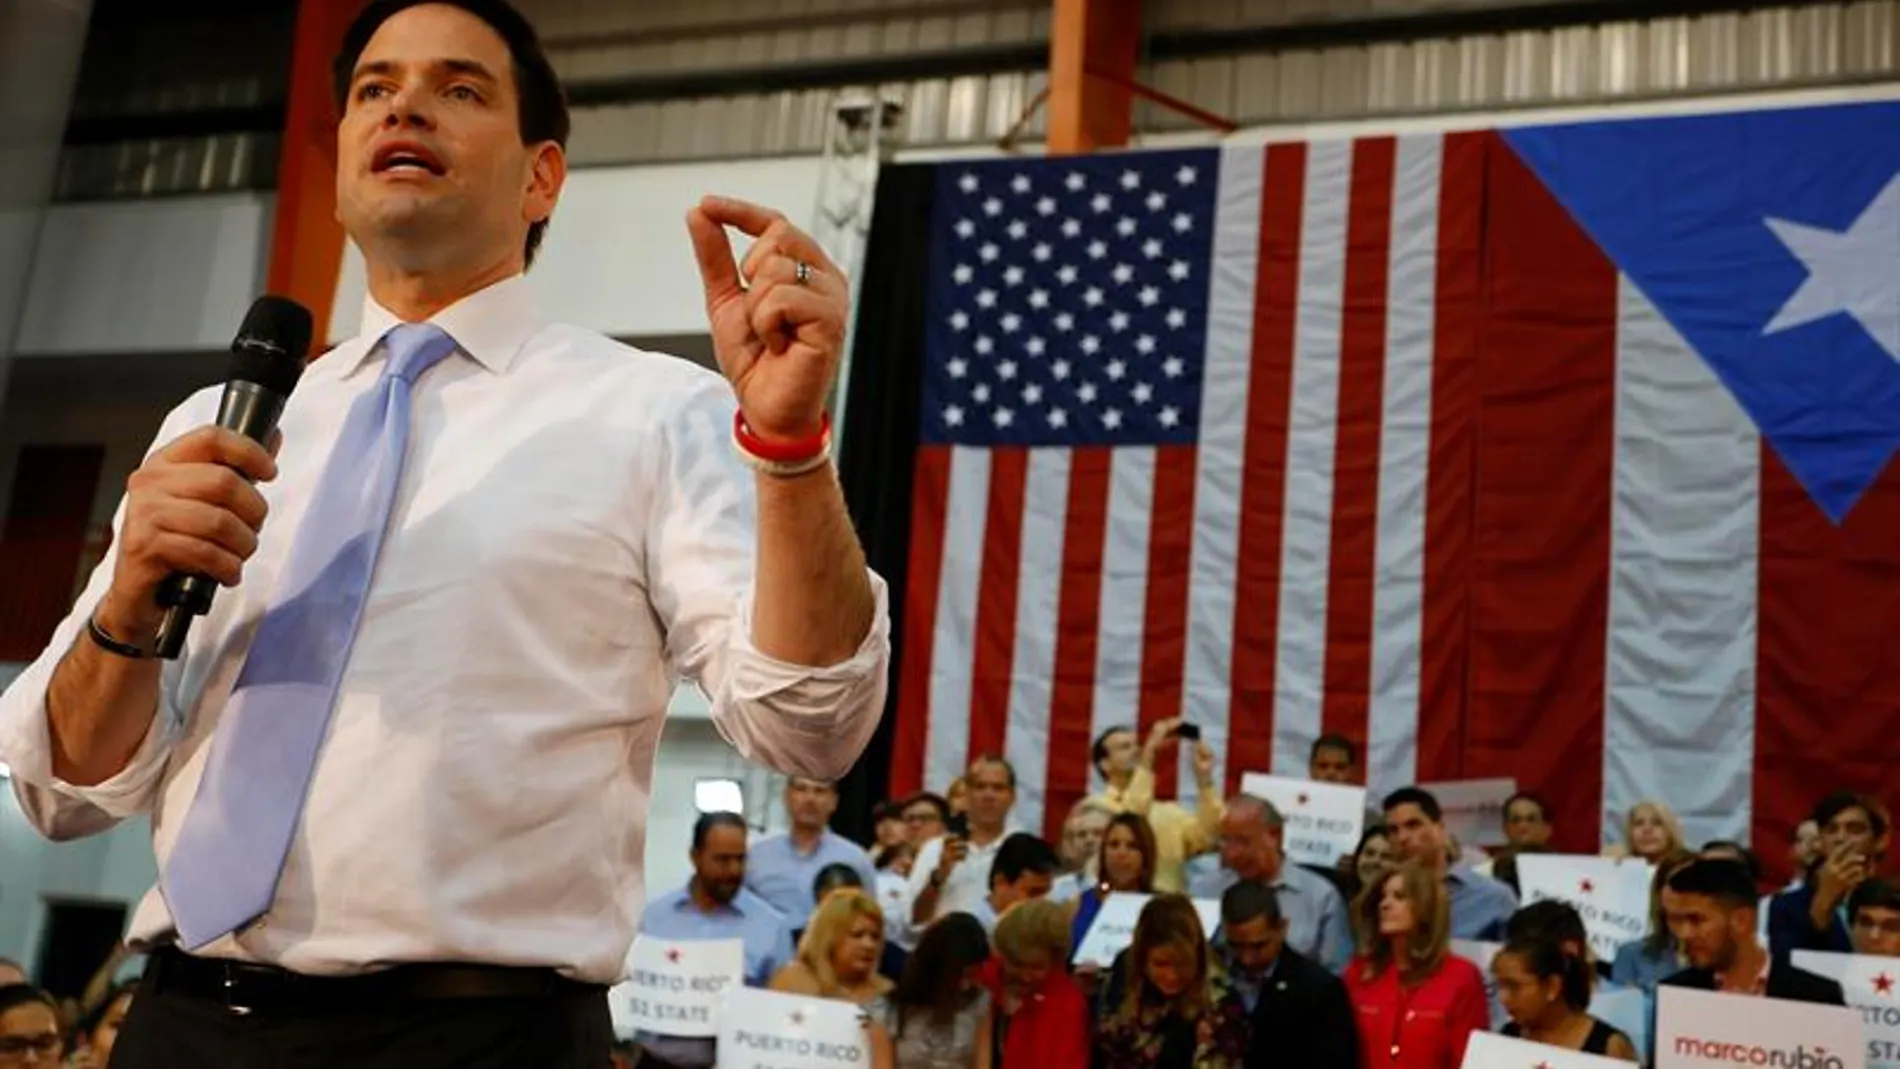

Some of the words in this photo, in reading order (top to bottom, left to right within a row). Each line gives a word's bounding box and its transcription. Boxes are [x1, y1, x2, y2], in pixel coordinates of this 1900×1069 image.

[655, 1003, 710, 1024] STATE
[734, 1029, 811, 1057] PUERTO
[815, 1041, 861, 1063] RICO
[1674, 1036, 1844, 1069] marcorubio
